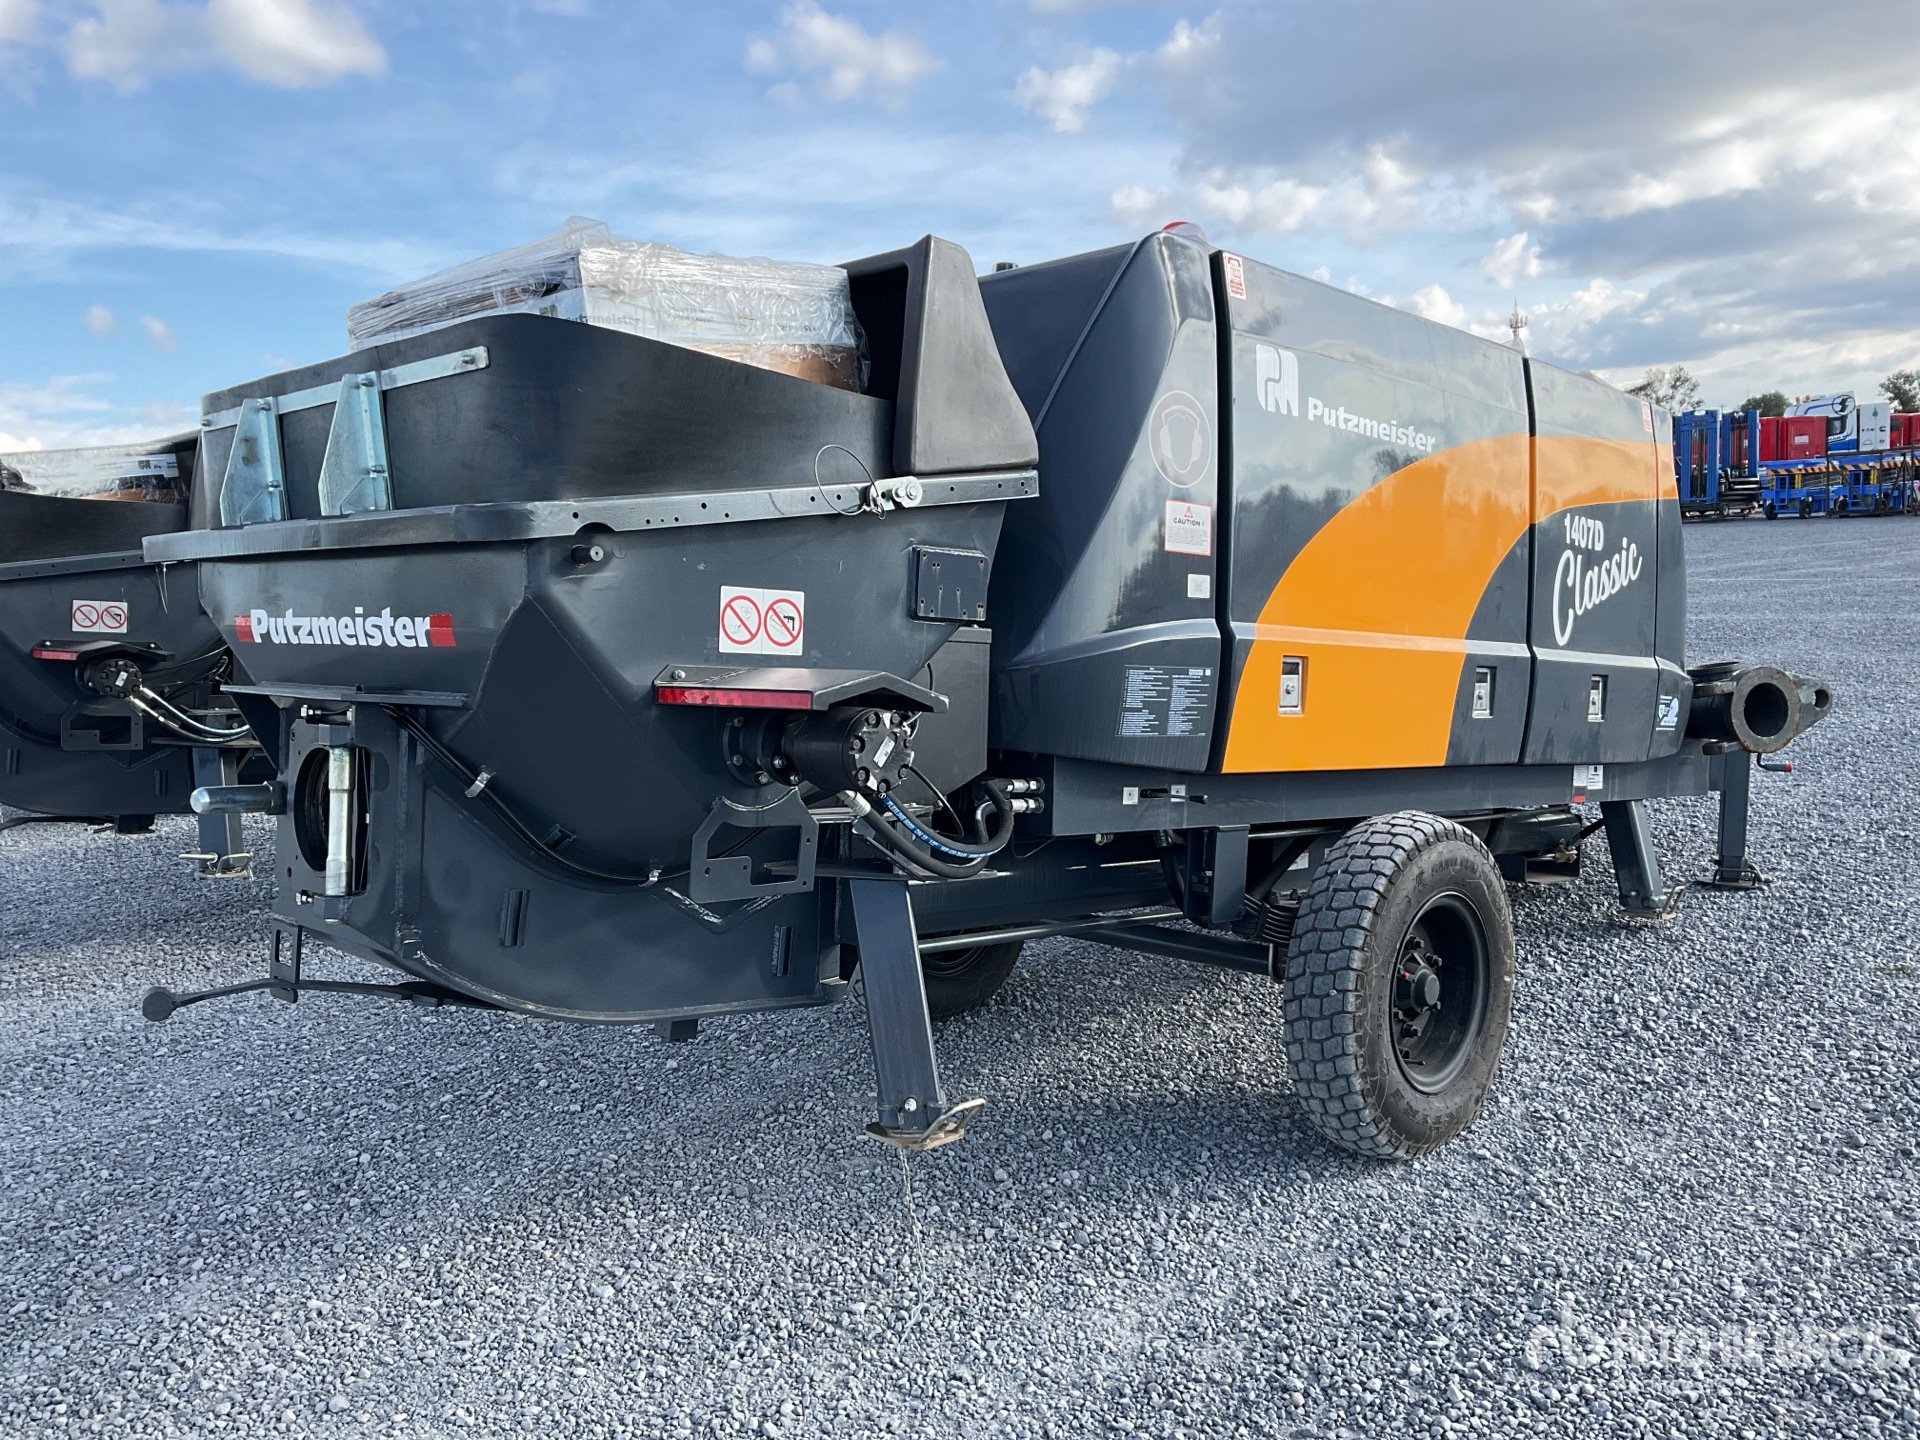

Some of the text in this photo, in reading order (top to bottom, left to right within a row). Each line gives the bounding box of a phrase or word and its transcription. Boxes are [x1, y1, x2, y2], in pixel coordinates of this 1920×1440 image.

[1308, 396, 1436, 452] Putzmeister
[1173, 517, 1200, 527] CAUTION
[1564, 512, 1604, 551] 1407D
[1553, 536, 1643, 646] Classic
[250, 606, 431, 648] Putzmeister
